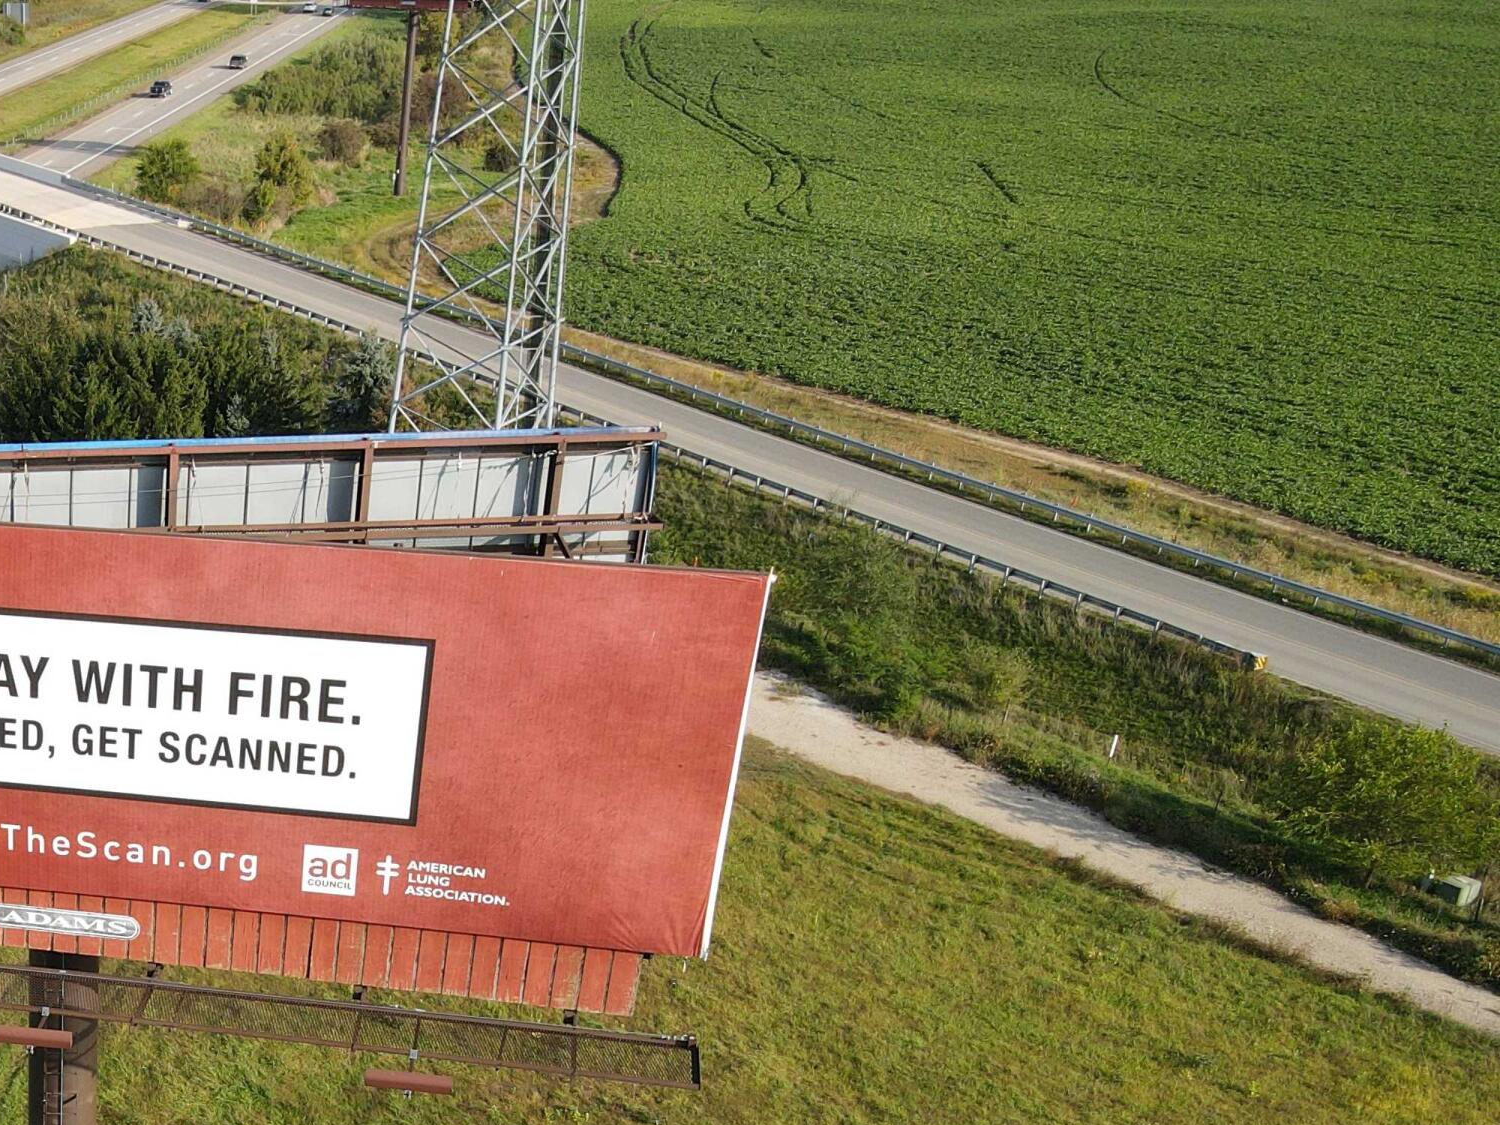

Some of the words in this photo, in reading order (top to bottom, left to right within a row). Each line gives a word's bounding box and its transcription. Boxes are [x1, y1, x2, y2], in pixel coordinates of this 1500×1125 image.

[71, 659, 203, 713] WITH
[228, 671, 361, 726] FIRE.
[72, 723, 143, 760] GET
[158, 731, 356, 780] SCANNED.
[308, 853, 352, 880] ad
[406, 860, 487, 880] AMERICAN
[308, 878, 352, 891] COUNCIL
[408, 873, 450, 887] LUNG
[2, 910, 129, 935] ADAMS
